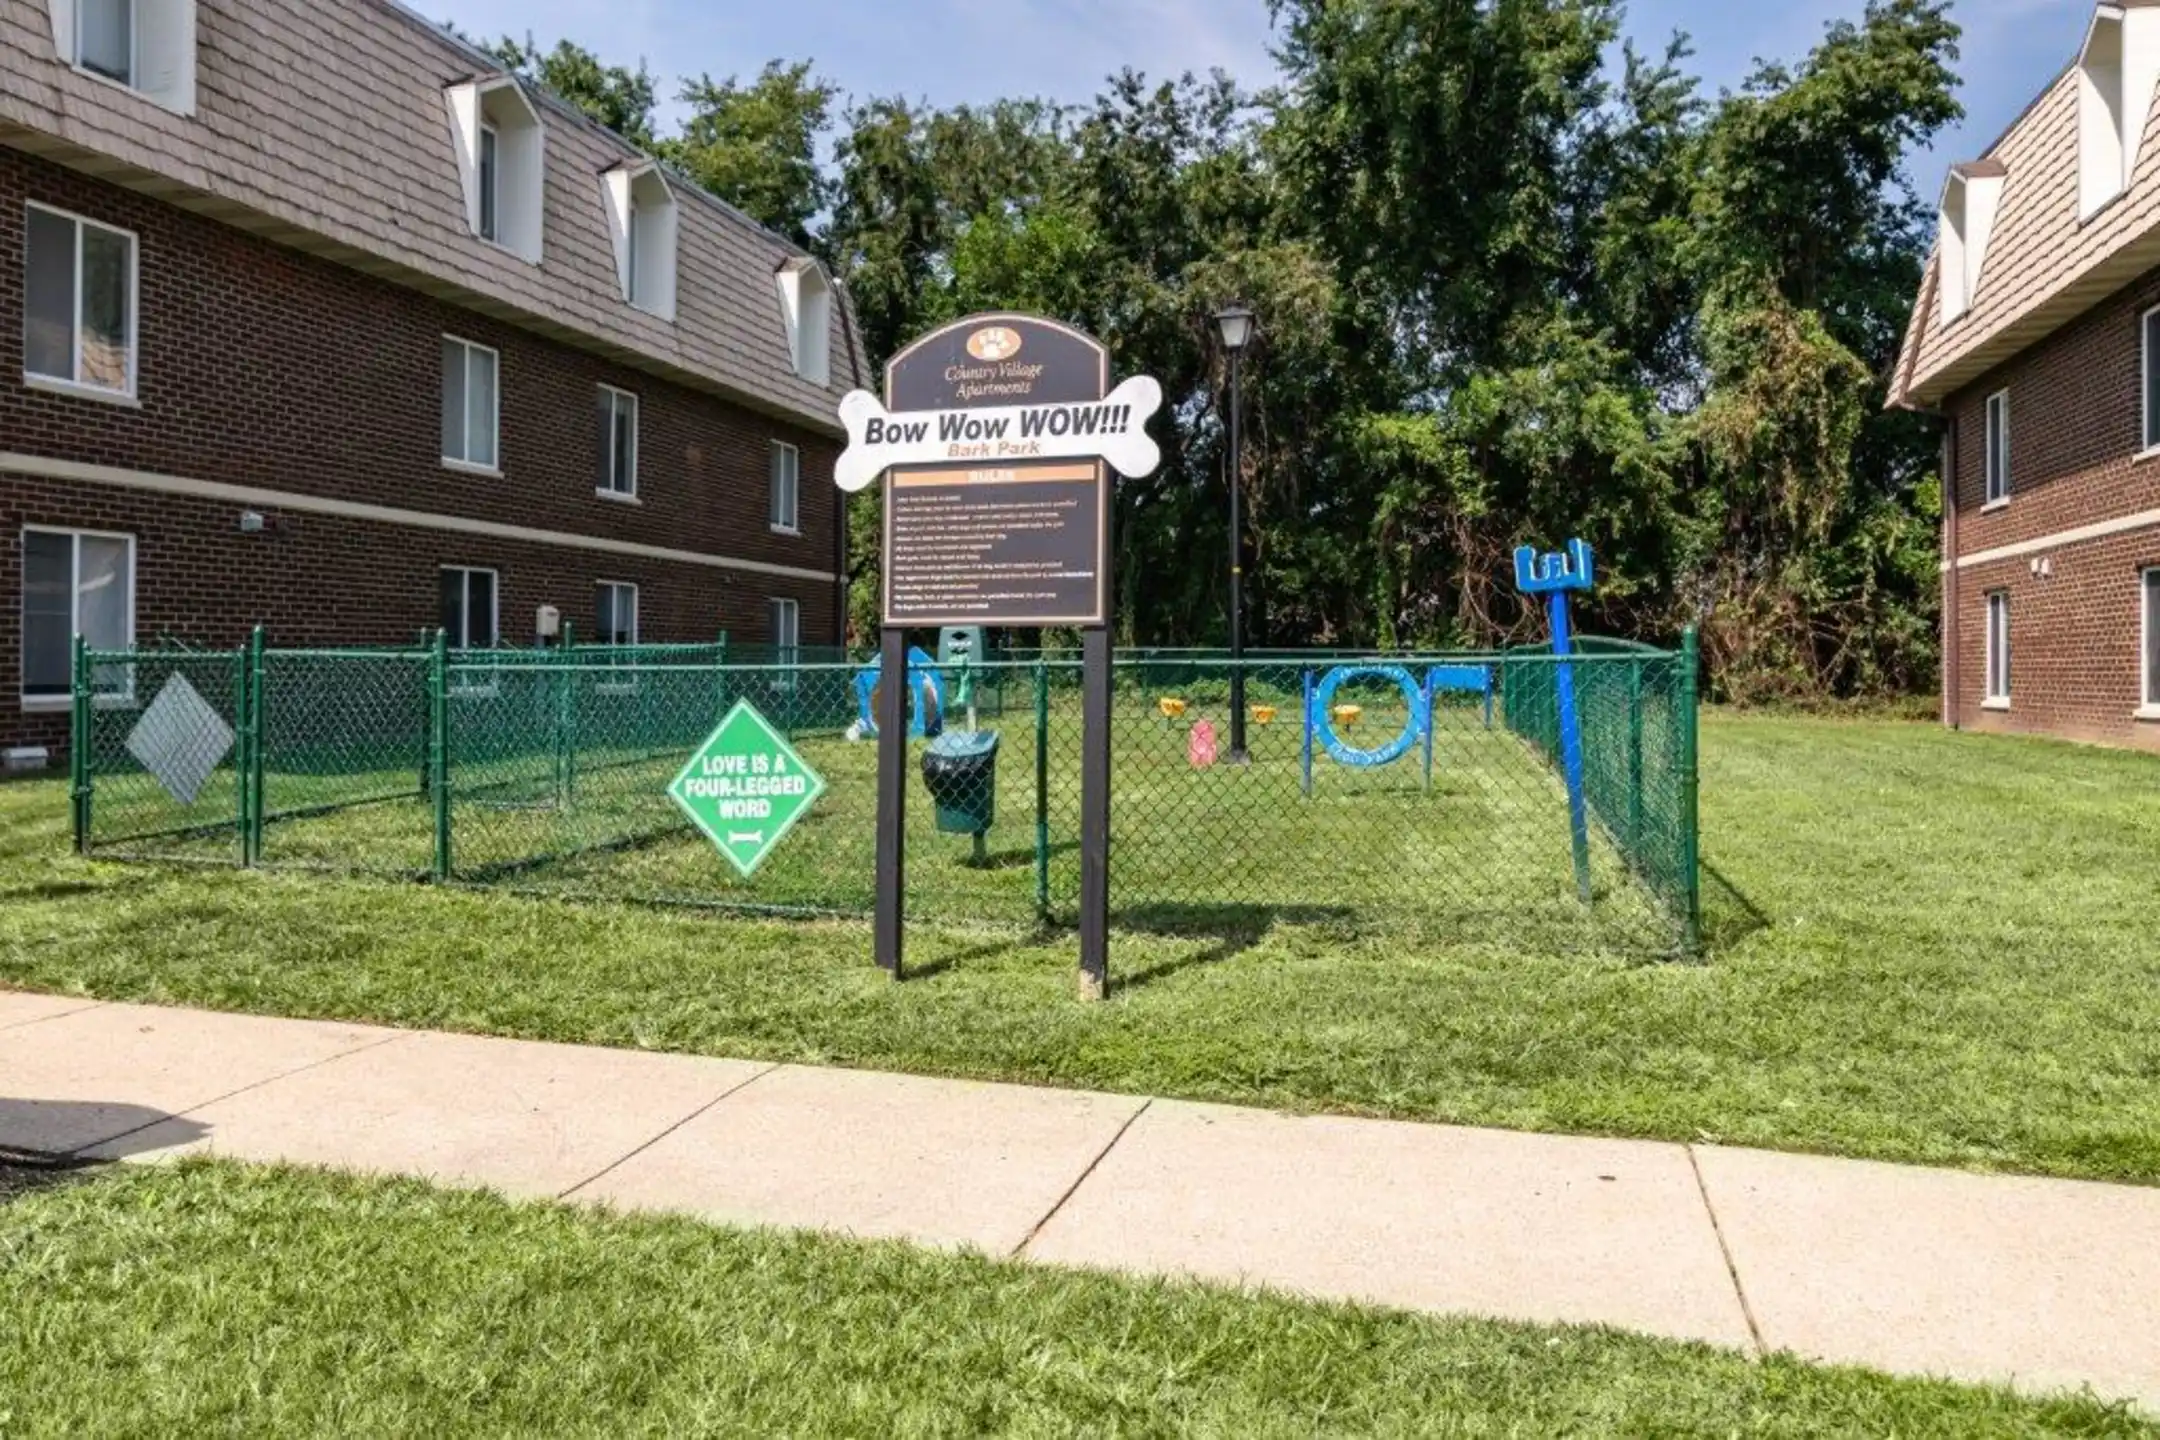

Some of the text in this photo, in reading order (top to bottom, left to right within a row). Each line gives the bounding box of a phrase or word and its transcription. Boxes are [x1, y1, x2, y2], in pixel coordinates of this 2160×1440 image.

[945, 361, 1043, 384] Country Village
[956, 381, 1031, 400] Apartments
[864, 404, 1131, 444] Bow Wow WOW!!!
[948, 440, 1040, 457] Bark Park
[703, 753, 786, 775] LOVE IS A
[685, 776, 805, 797] FOUR-LEGGED
[719, 798, 772, 819] WORD
